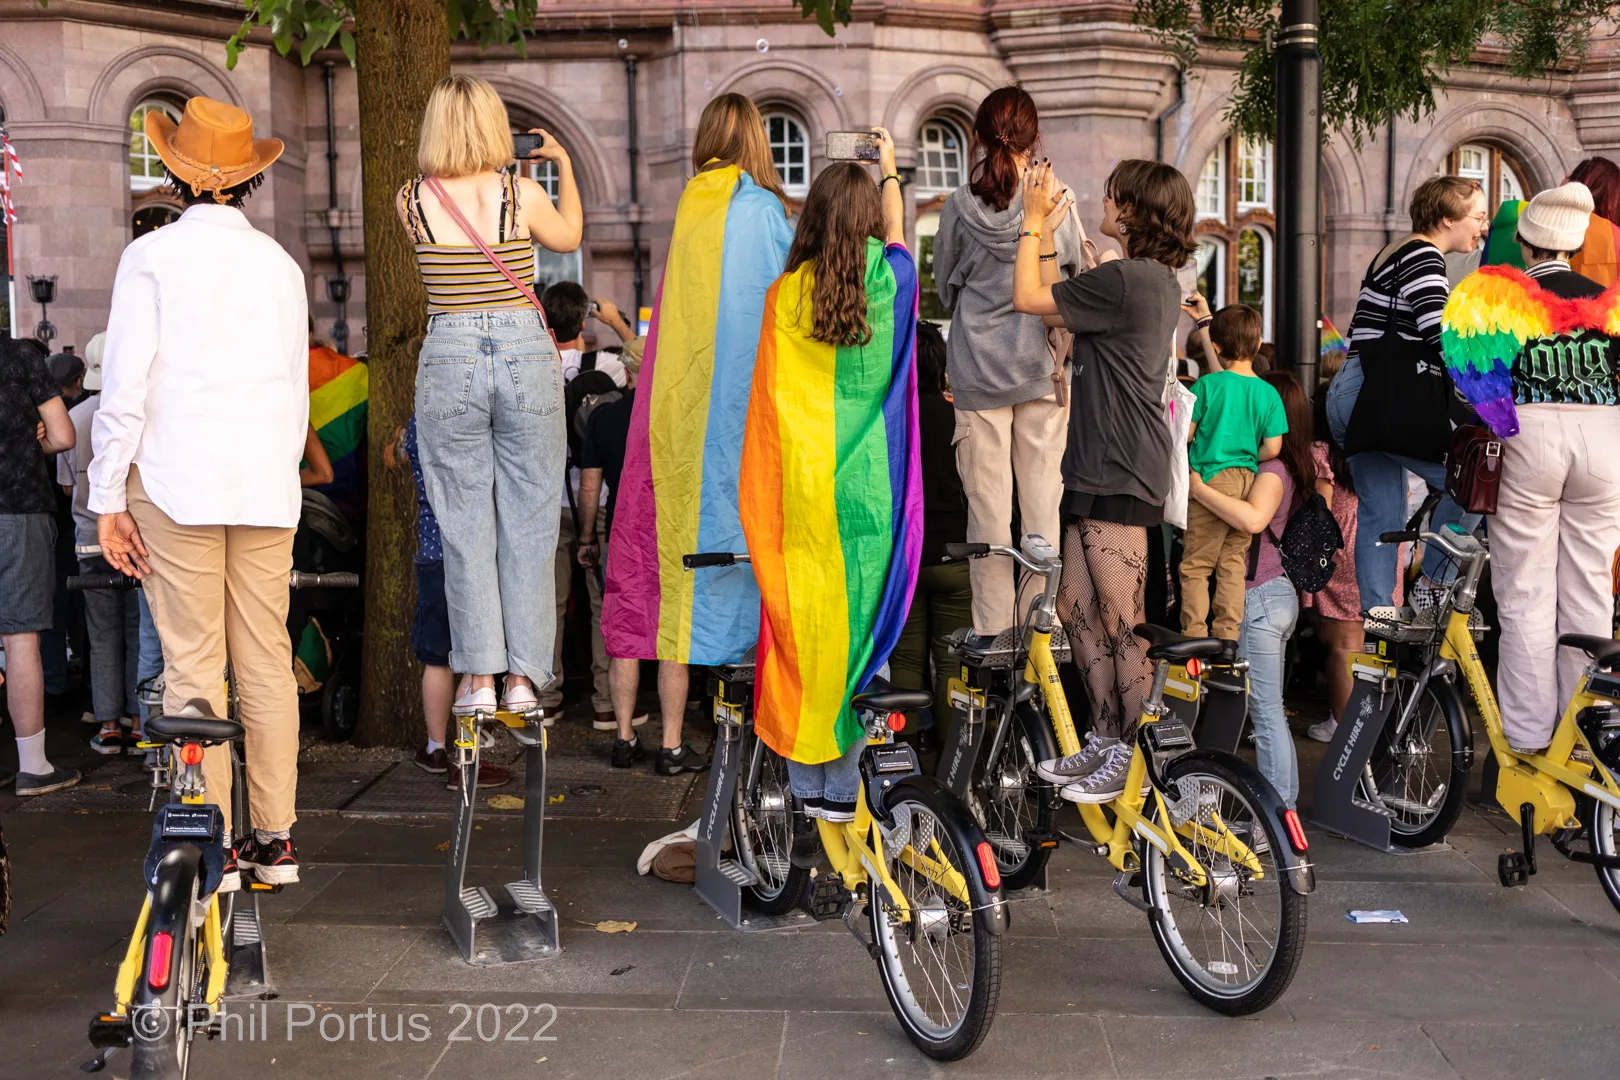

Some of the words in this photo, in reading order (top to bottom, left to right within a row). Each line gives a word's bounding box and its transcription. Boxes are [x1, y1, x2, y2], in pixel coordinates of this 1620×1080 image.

[949, 747, 963, 780] HIRE
[1333, 744, 1353, 781] CYCLE
[1347, 717, 1365, 748] HIRE
[706, 799, 719, 840] CYCLE
[715, 767, 725, 802] HIRE
